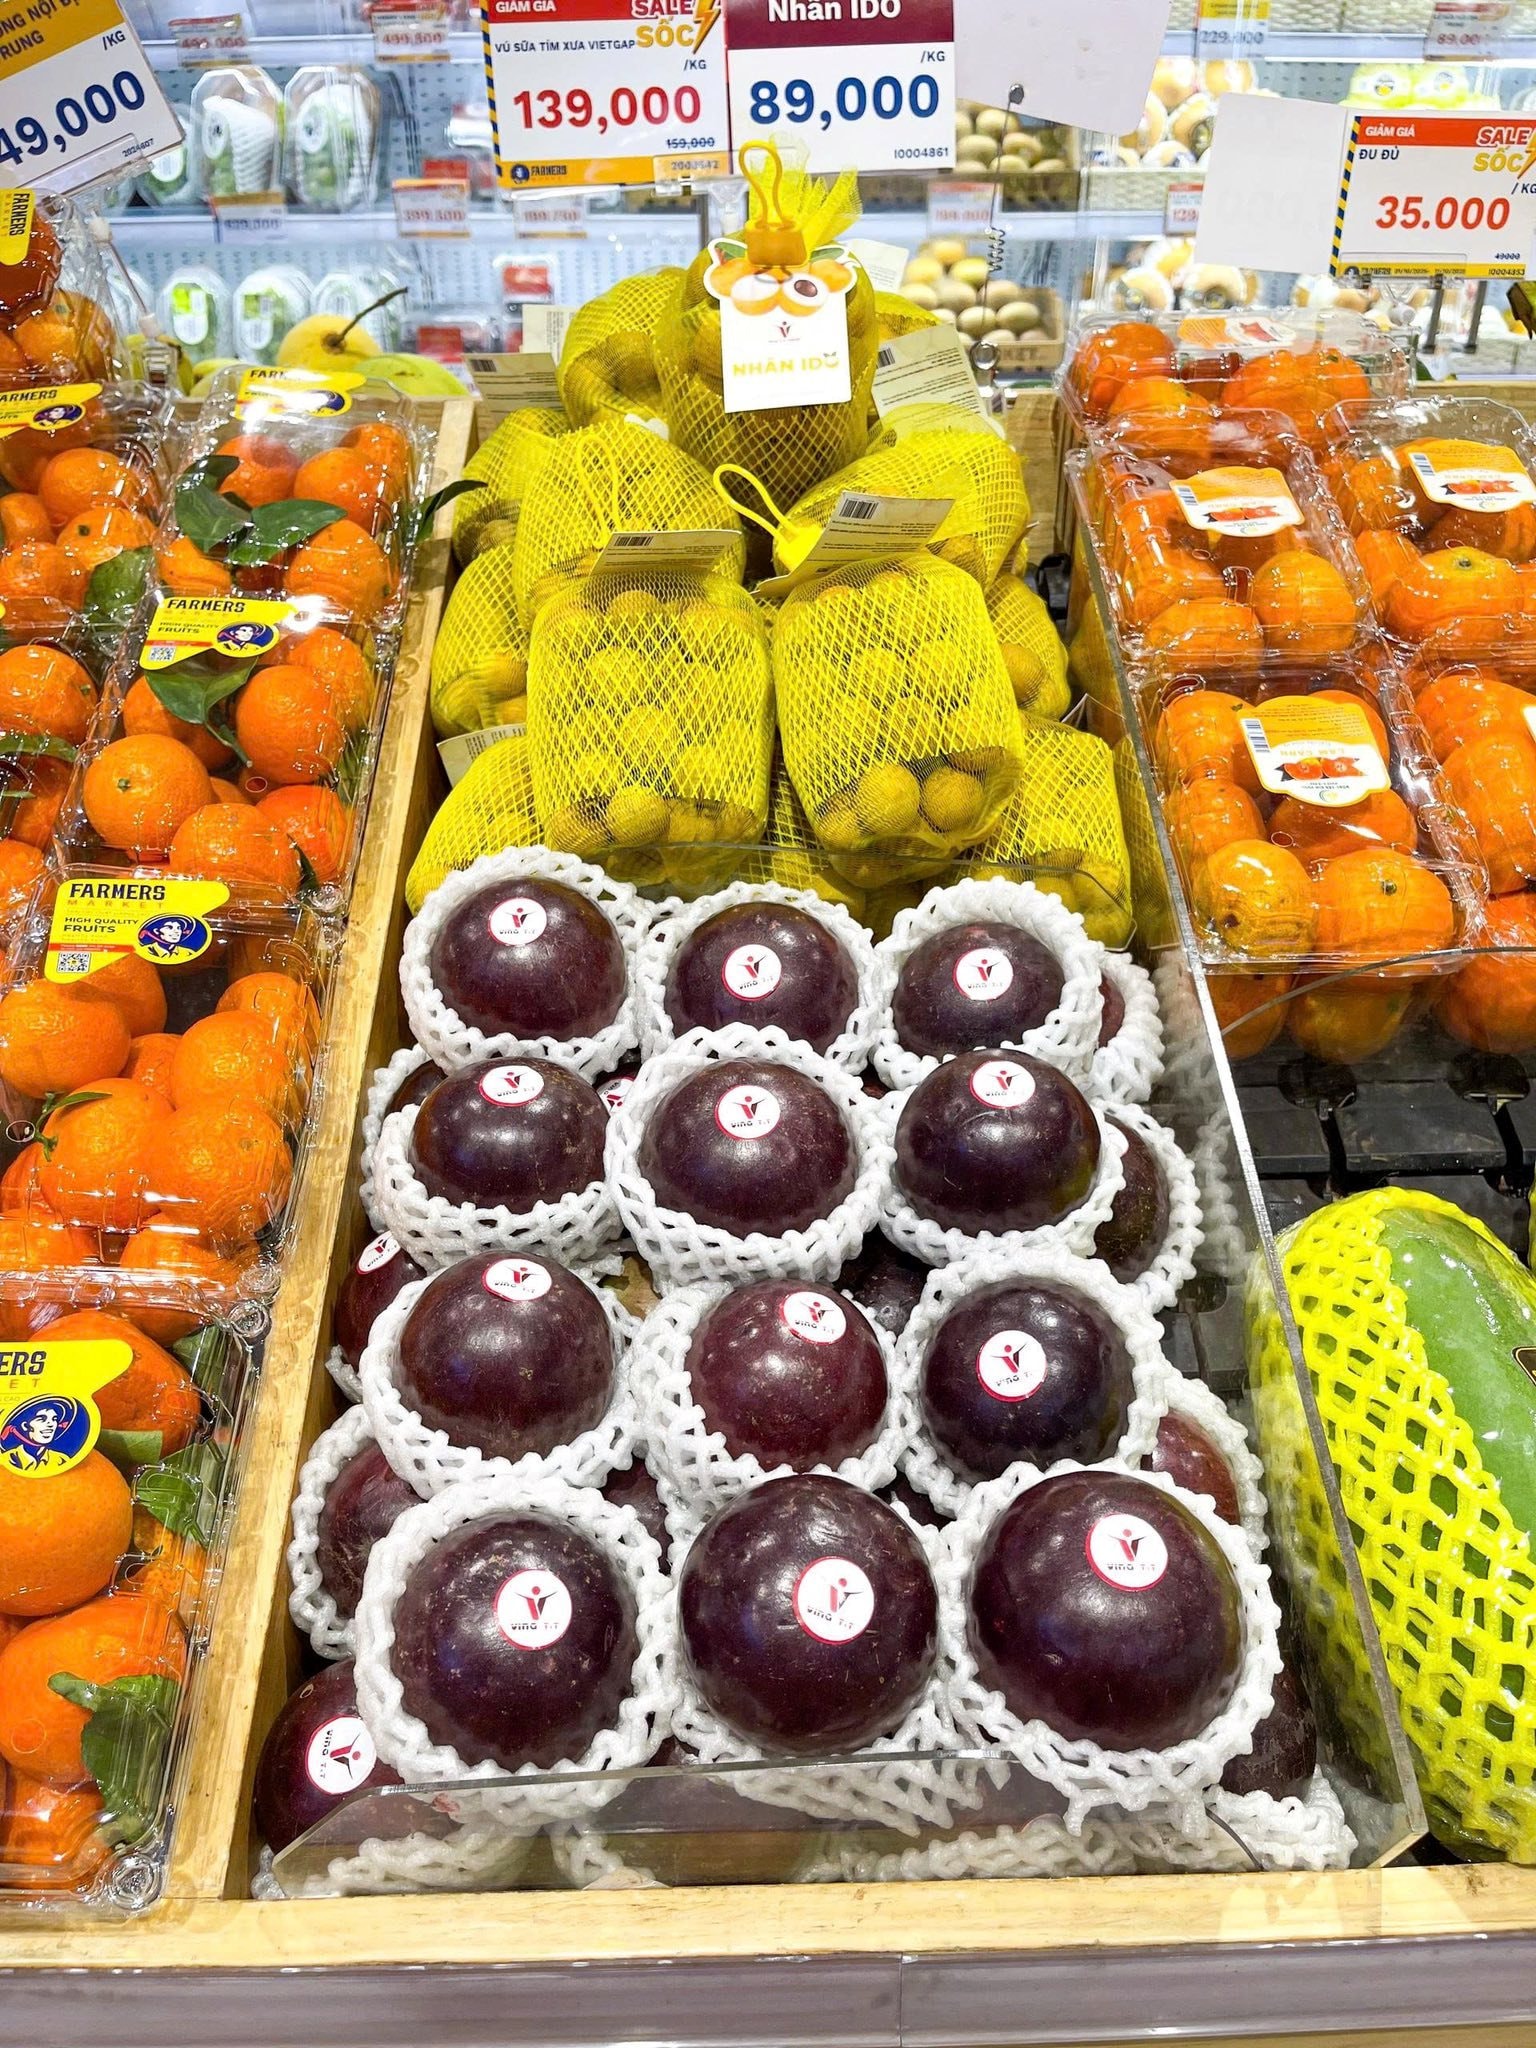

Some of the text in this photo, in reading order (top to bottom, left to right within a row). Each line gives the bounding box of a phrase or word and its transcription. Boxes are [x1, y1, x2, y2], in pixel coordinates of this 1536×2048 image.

[633, 0, 694, 17] SALE
[851, 0, 901, 20] IDO
[0, 13, 26, 38] NG
[635, 17, 694, 48] SỐC
[102, 30, 126, 51] /KG
[494, 39, 511, 53] VÚ
[513, 37, 536, 52] SỮA
[562, 40, 585, 51] XƯA
[588, 39, 636, 50] VIETGAP
[683, 59, 707, 71] /KG
[920, 50, 946, 63] /KG
[513, 85, 702, 135] 139,000
[749, 74, 939, 131] 89,000
[666, 137, 716, 149] 159,000
[1365, 122, 1530, 147] GIẢM GIÁ SALE
[1358, 145, 1524, 173] ĐU ĐỦ SỐC
[9, 193, 30, 236] FARMERS
[1375, 195, 1511, 231] 35.000
[732, 357, 795, 377] NHÃN
[0, 389, 58, 402] ARMERS
[167, 599, 246, 613] FARMERS
[69, 883, 166, 901] FARMERS
[67, 899, 165, 910] MARKET
[0, 1351, 47, 1376] ERS
